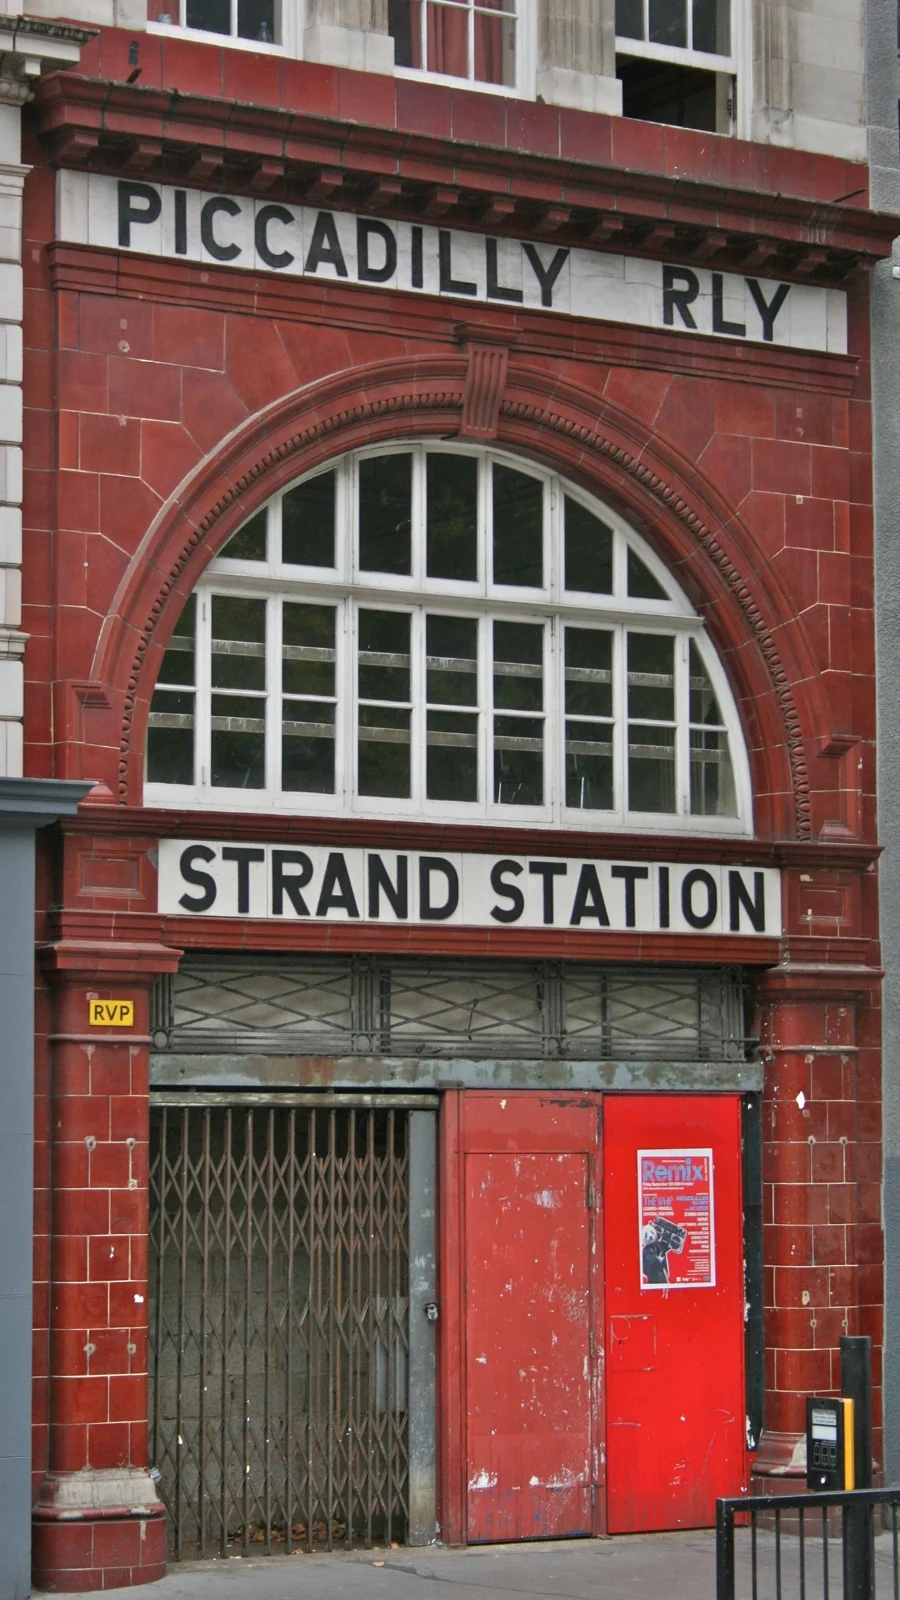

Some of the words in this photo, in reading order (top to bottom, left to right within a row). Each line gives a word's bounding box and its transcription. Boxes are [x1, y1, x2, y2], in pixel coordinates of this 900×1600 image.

[118, 180, 570, 307] PICCADILLY
[662, 264, 791, 342] RLY
[179, 844, 459, 921] STRAND
[490, 858, 766, 933] STATION
[94, 1004, 130, 1021] RVP
[642, 1158, 704, 1182] Remix
